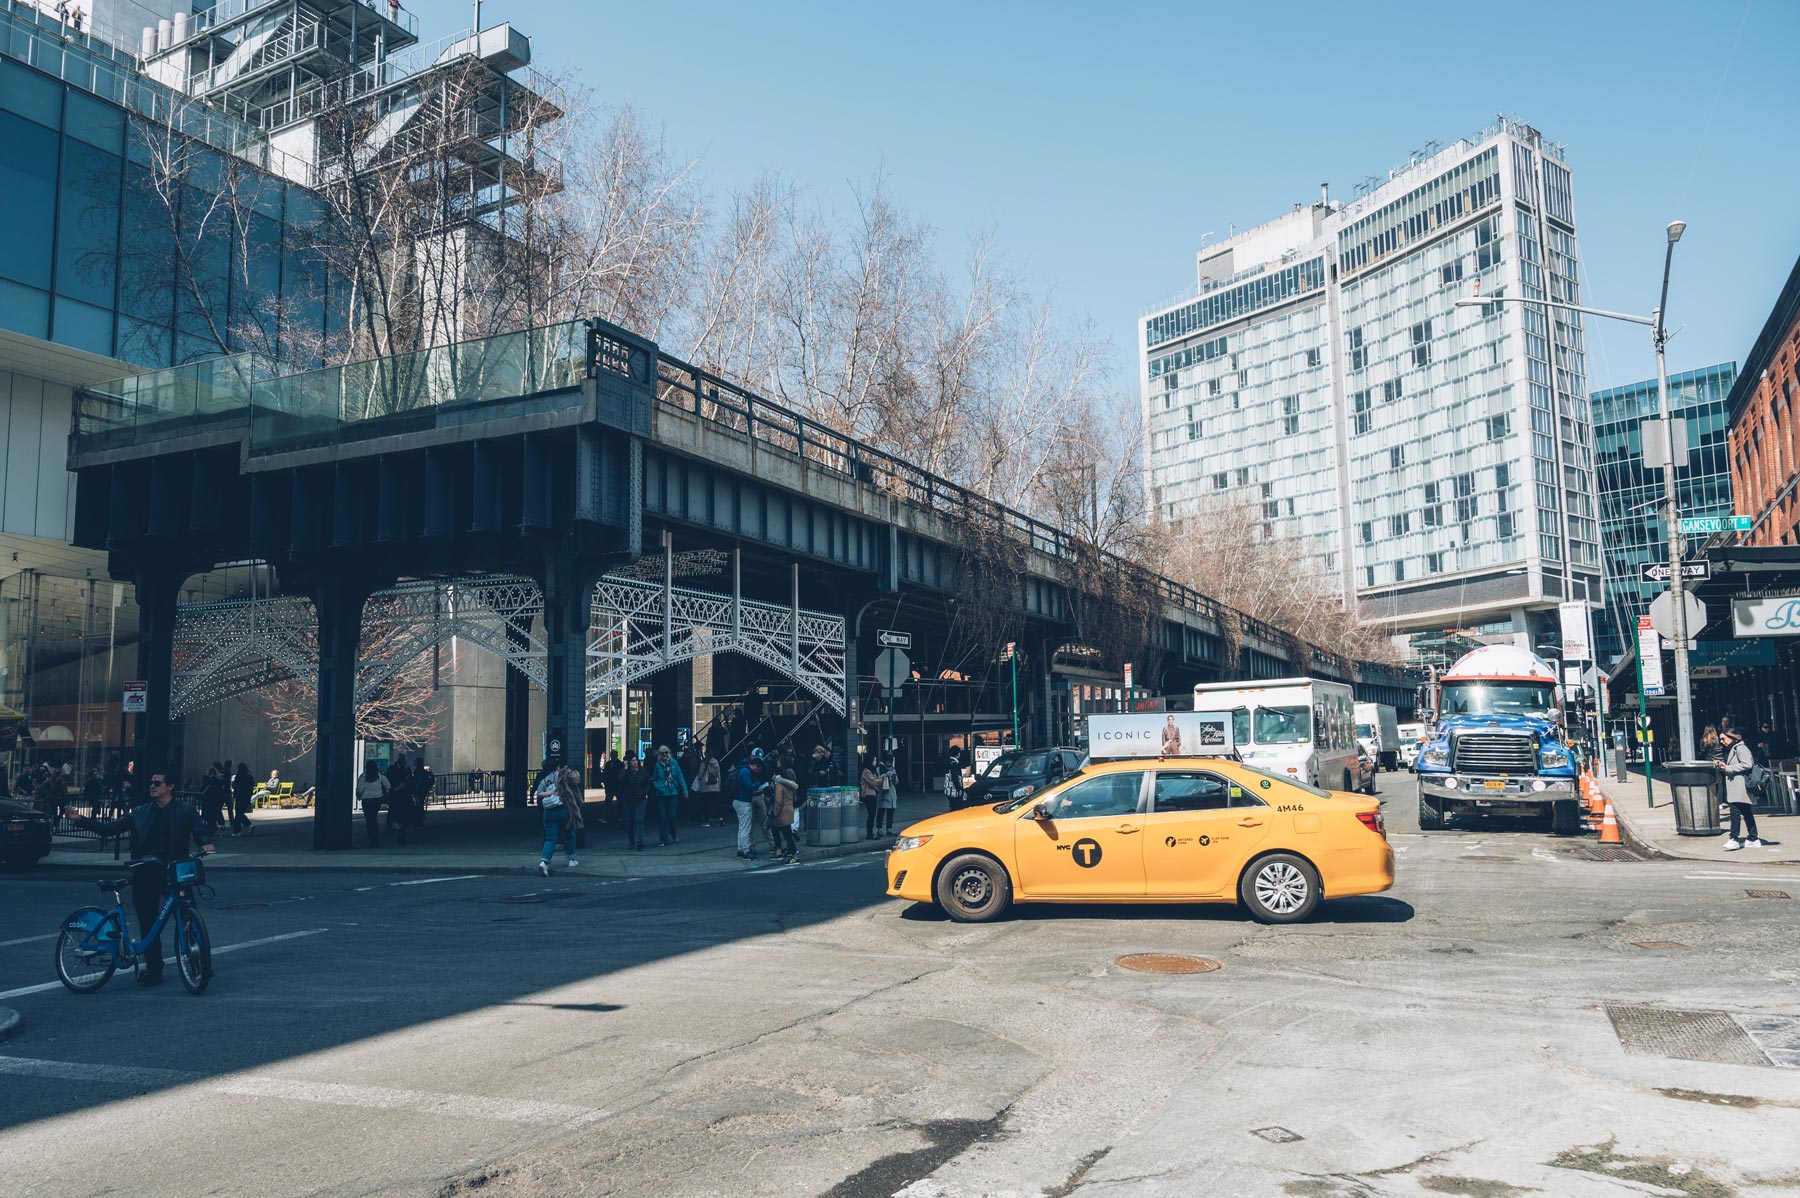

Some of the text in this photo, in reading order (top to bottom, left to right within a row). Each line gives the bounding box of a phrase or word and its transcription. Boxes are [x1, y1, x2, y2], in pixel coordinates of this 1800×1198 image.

[1682, 518, 1738, 532] GANSEVOORT
[1651, 566, 1671, 576] ONE
[1097, 730, 1151, 740] ICONIC
[1276, 803, 1304, 813] 4M46
[1078, 843, 1095, 865] T
